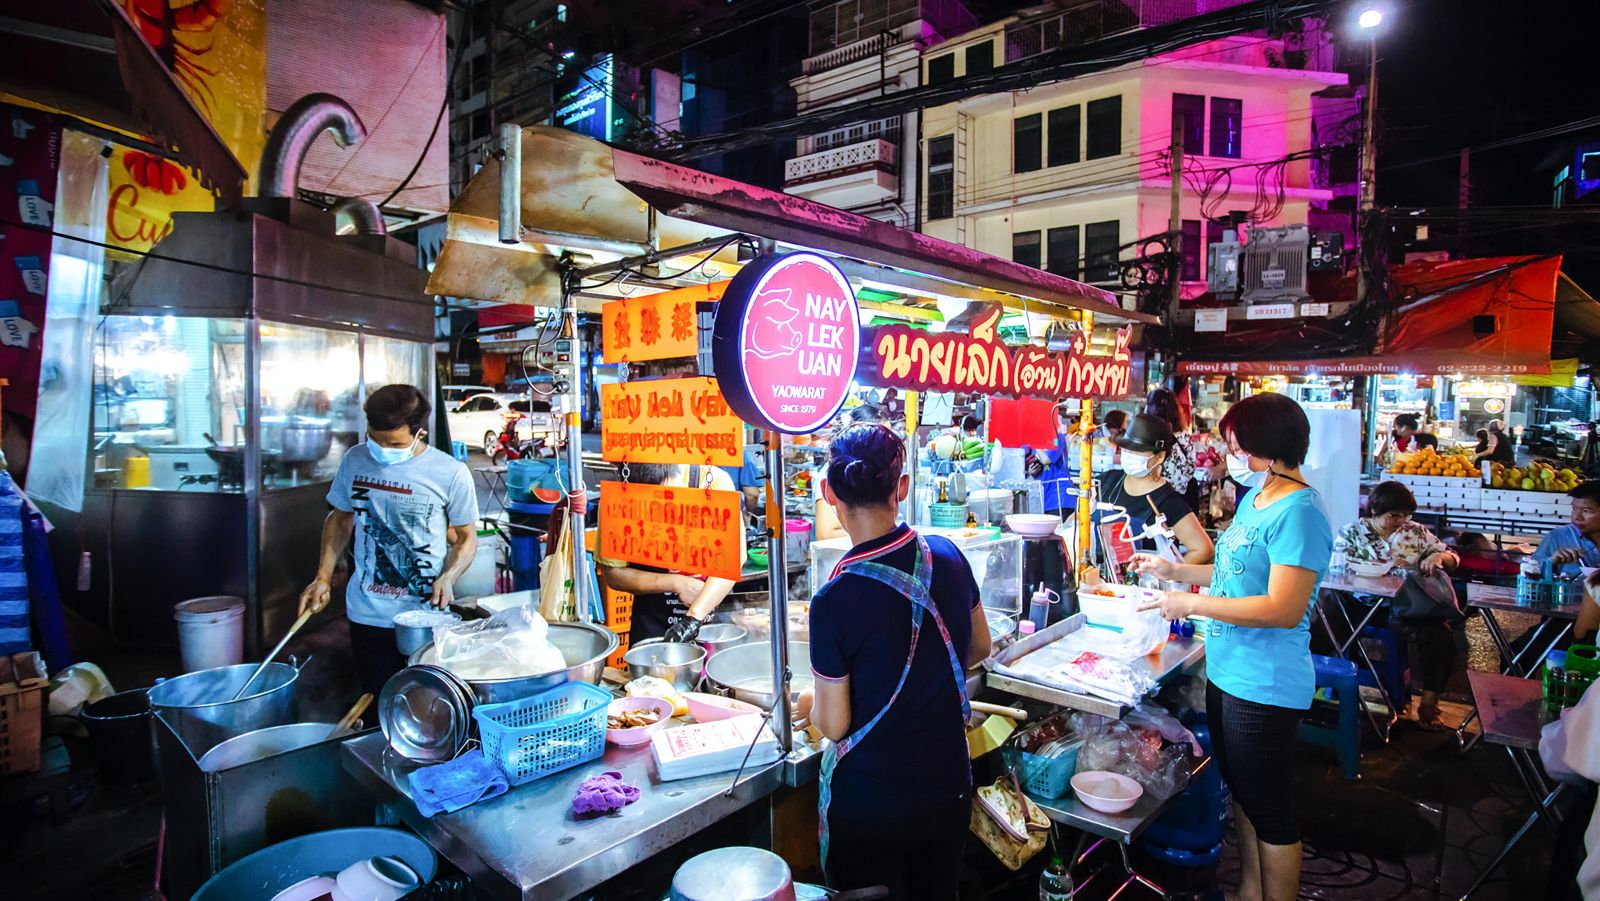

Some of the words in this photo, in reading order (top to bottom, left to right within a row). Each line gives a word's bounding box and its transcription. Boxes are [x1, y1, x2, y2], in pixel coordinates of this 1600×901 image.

[26, 198, 40, 220] LOVE
[804, 292, 849, 323] NAY
[4, 319, 23, 341] LOVE
[807, 322, 846, 350] LEK
[798, 349, 842, 377] UAN
[771, 384, 827, 400] YAOWARAT
[779, 403, 800, 414] SINCE
[800, 404, 817, 414] 1979
